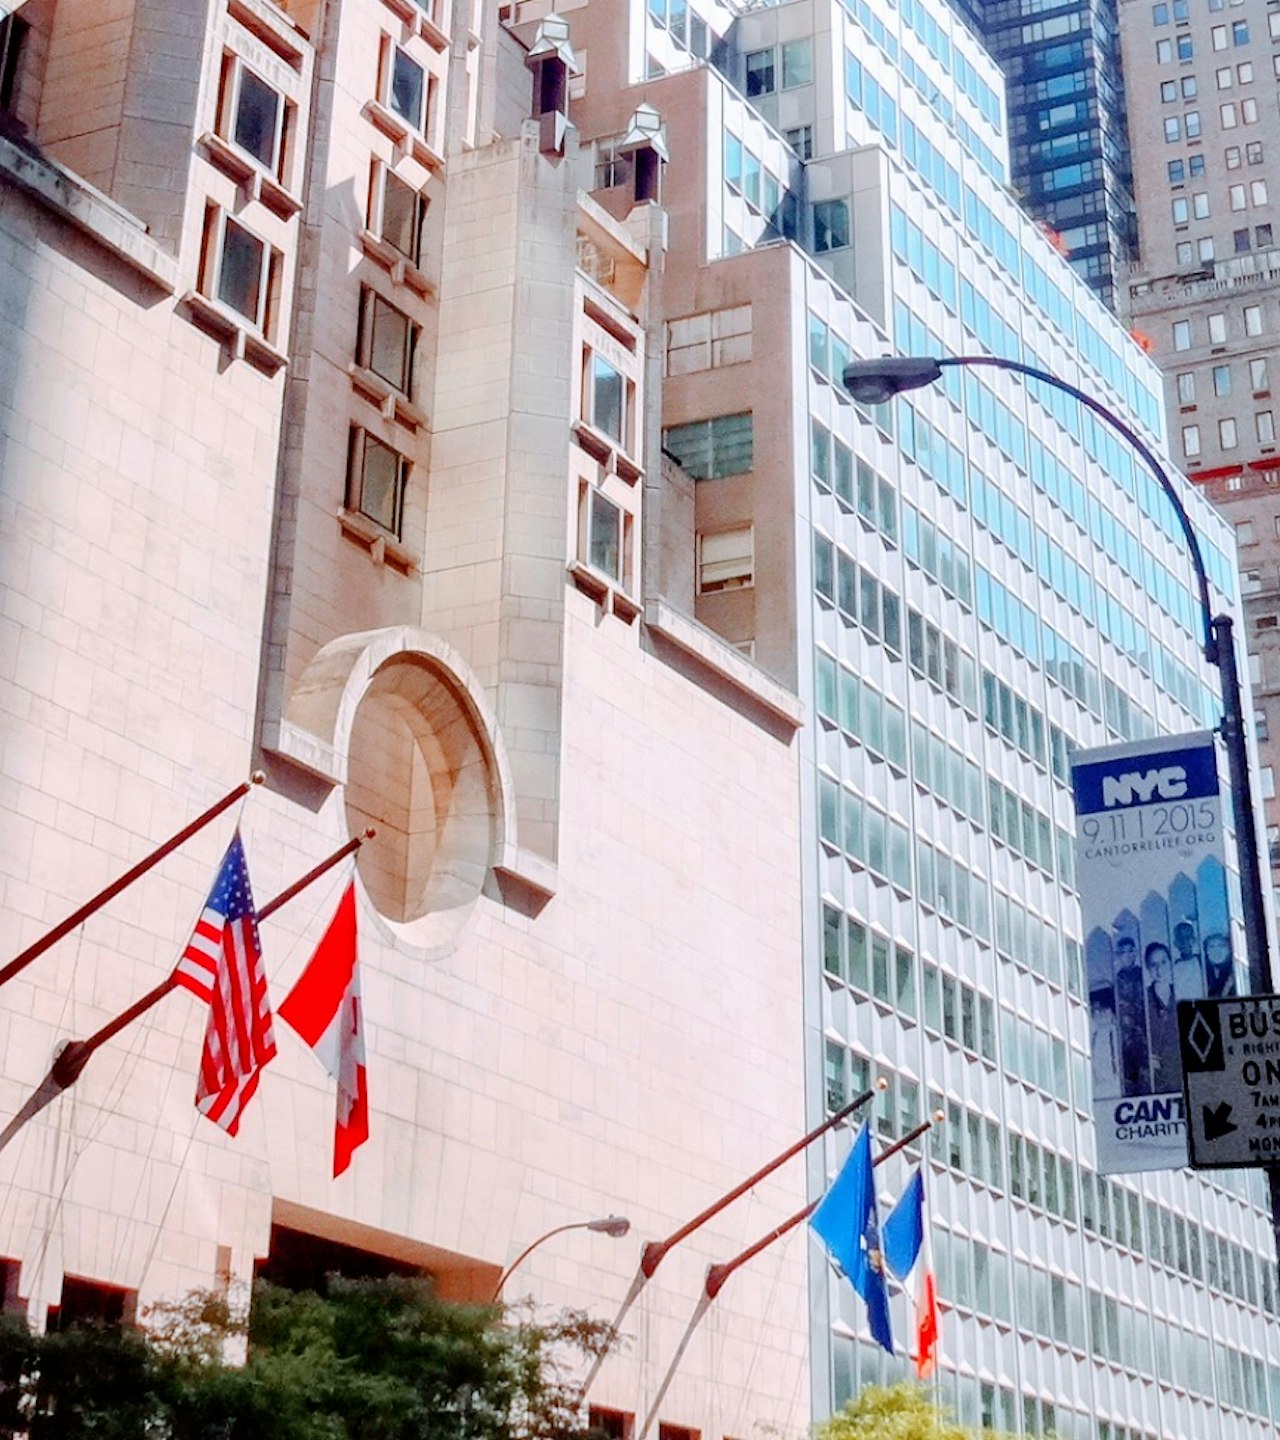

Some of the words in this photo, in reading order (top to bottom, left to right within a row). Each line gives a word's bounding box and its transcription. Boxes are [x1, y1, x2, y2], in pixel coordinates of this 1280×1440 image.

[1102, 765, 1188, 807] NYC
[1082, 813, 1126, 845] 9.11
[1153, 800, 1216, 836] 2015
[1243, 1042, 1280, 1055] RIGHT
